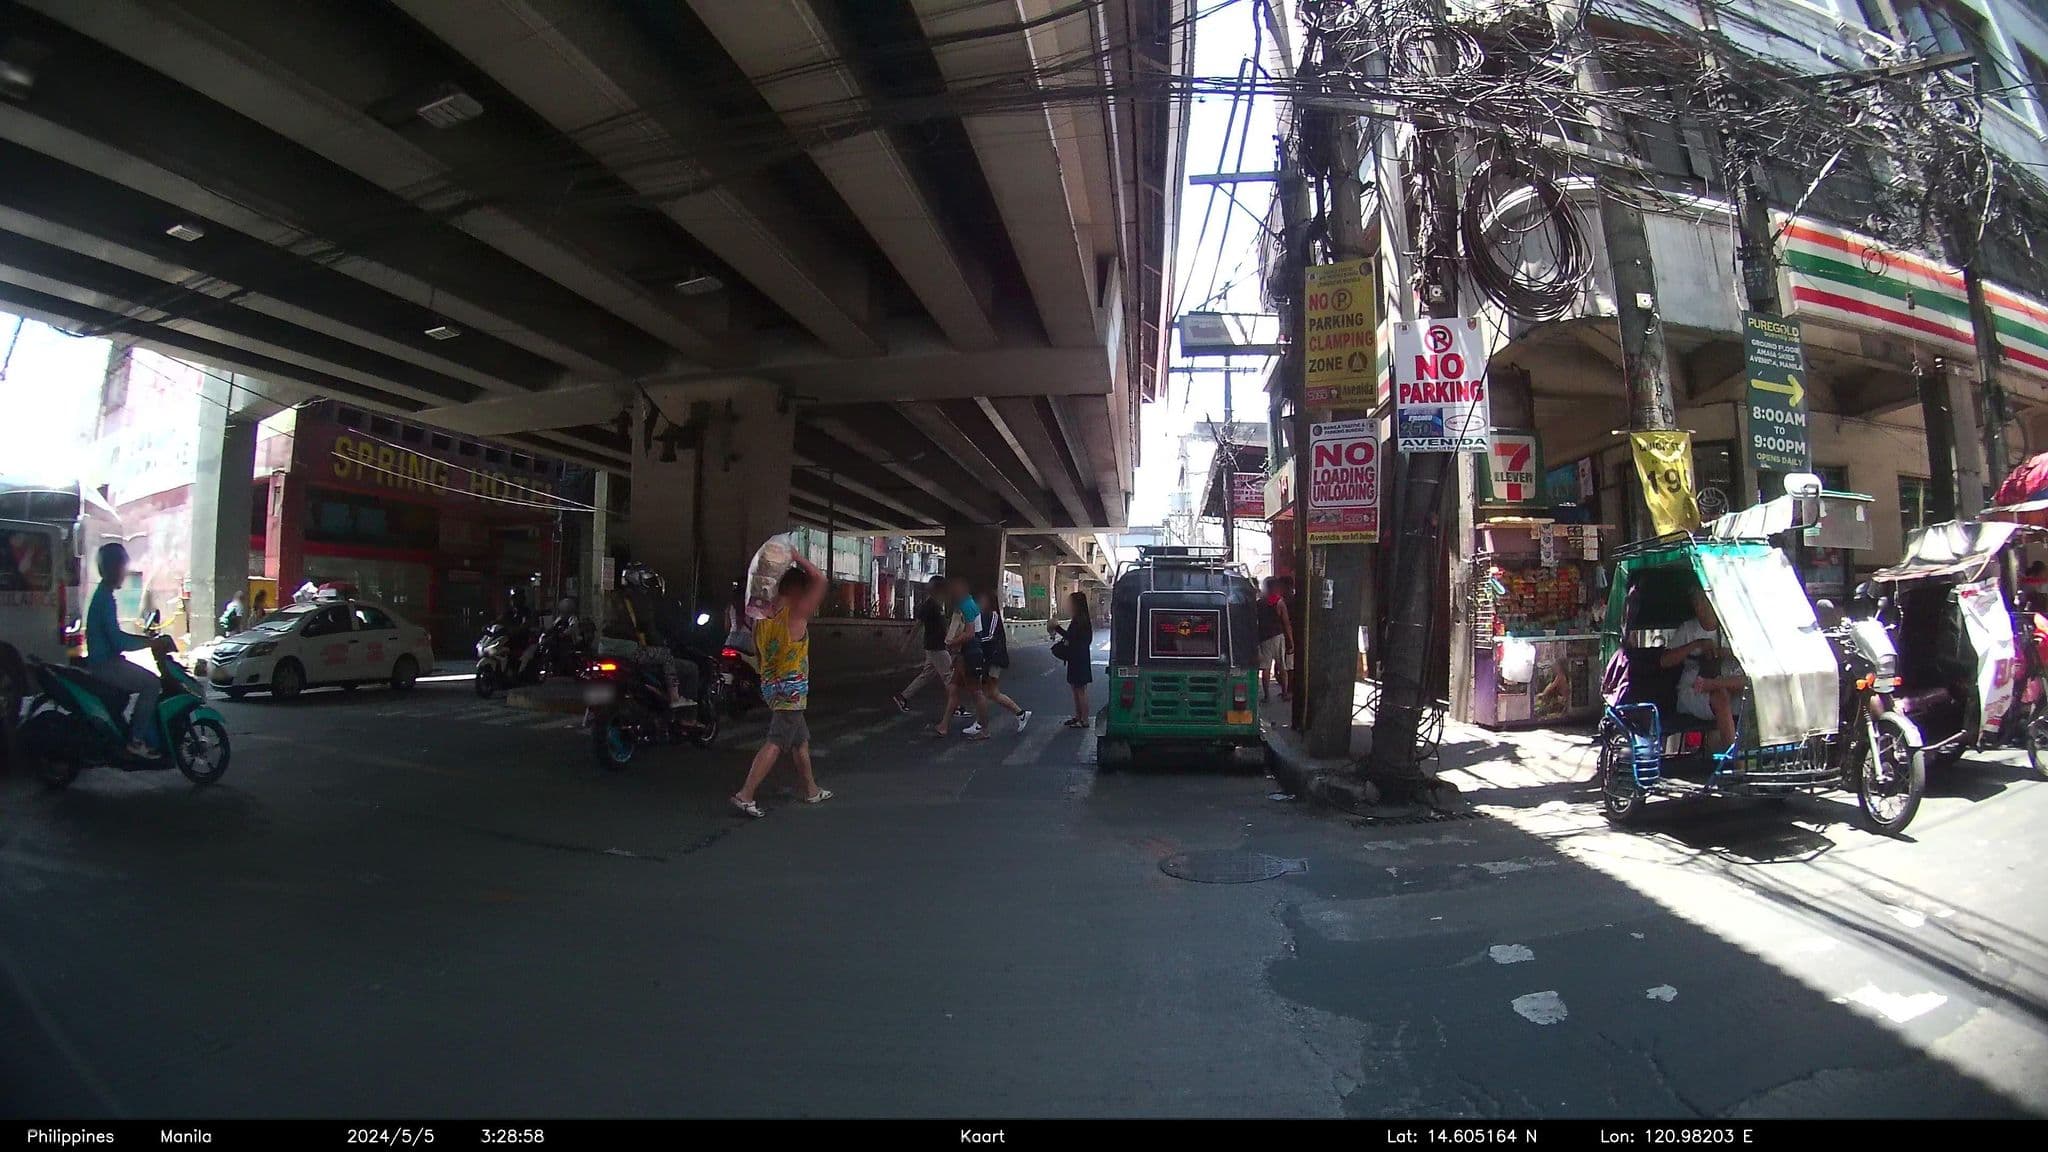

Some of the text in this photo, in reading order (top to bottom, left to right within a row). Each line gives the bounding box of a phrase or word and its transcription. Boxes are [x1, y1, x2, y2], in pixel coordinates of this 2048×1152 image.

[1309, 293, 1328, 311] NO
[1309, 313, 1364, 331] PARKING
[1748, 317, 1799, 337] PUREGOLD
[1309, 330, 1374, 352] CLAMPING
[1309, 356, 1343, 373] ZONE
[1415, 353, 1464, 381] NO
[1399, 380, 1484, 404] PARKING
[1753, 406, 1806, 427] 8:00AM
[1774, 426, 1786, 435] TO
[1401, 438, 1486, 446] AVENIDA
[1754, 434, 1806, 455] 9:00PM
[1315, 442, 1374, 468] NO
[1756, 452, 1781, 463] OPENS
[1782, 456, 1804, 467] DAILY
[333, 435, 450, 496] SPRING
[1494, 443, 1531, 501] 7
[1313, 467, 1375, 486] LOADING
[1313, 483, 1375, 502] UNLOADING
[906, 542, 946, 555] HOTEL
